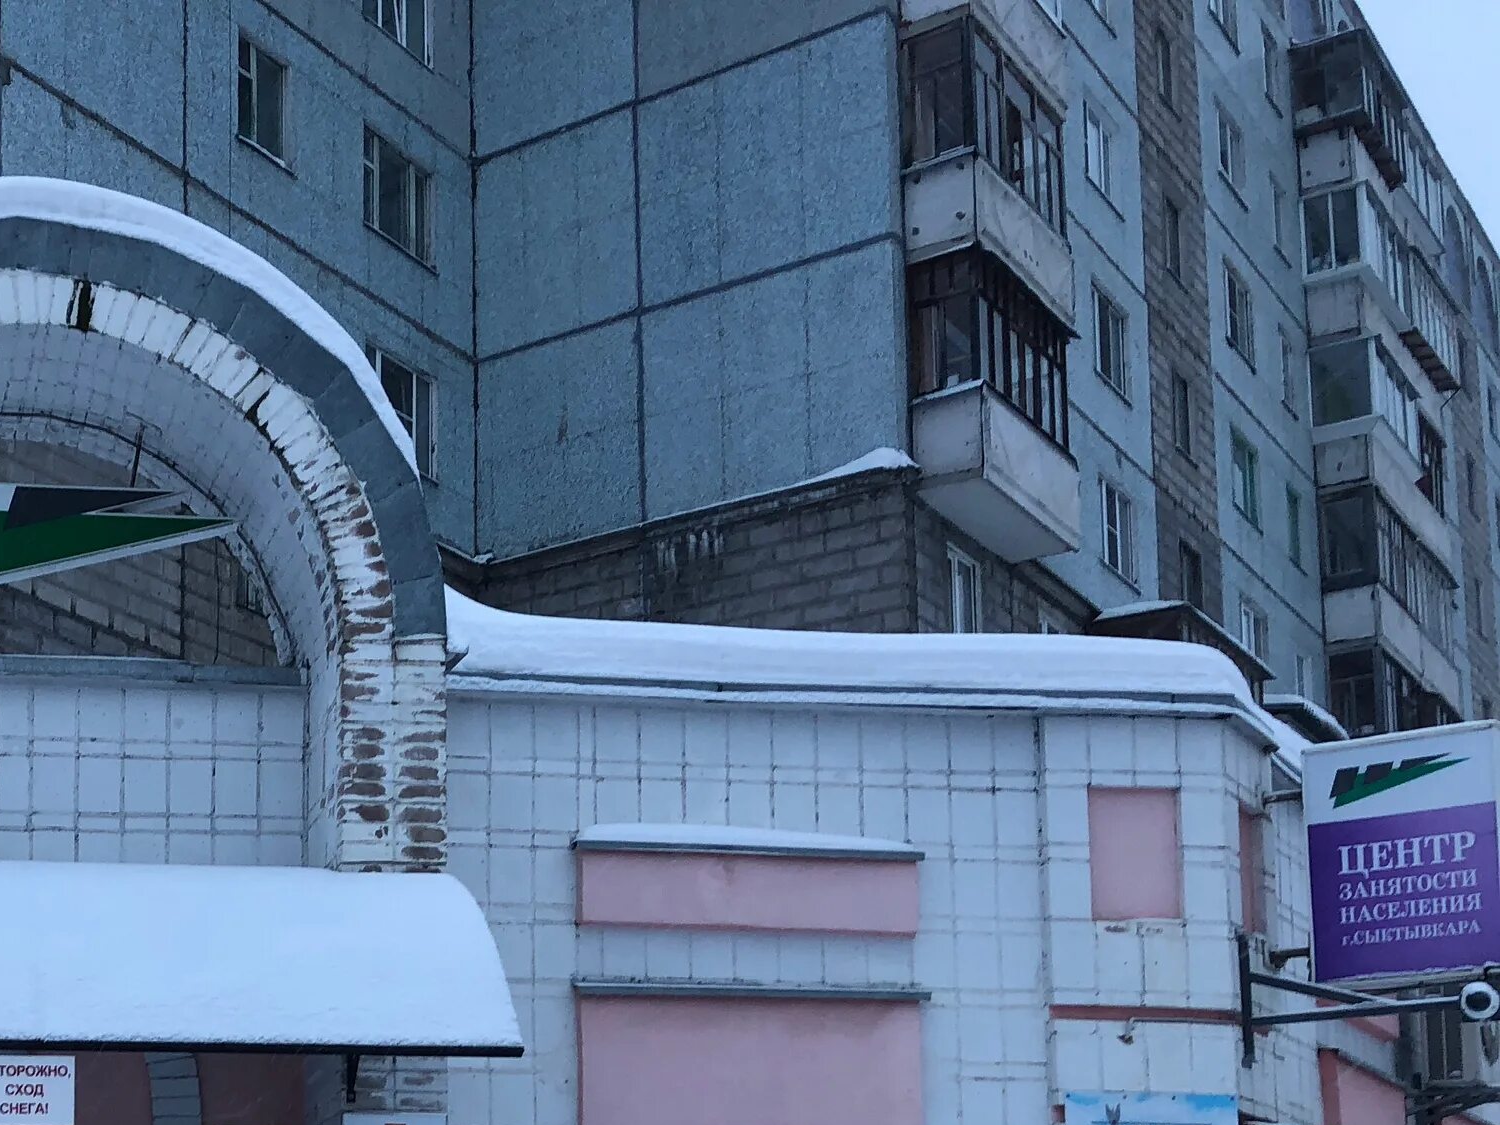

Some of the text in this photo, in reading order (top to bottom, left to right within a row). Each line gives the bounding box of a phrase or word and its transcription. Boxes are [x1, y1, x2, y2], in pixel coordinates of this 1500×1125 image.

[1337, 830, 1476, 879] ЦЕНТР
[1338, 868, 1477, 901] ЗАНЯТОСТИ
[1339, 892, 1483, 925] НАСЕЛЕНИЯ
[1341, 919, 1482, 947] г.СЫКТЫВКАРА
[5, 1083, 44, 1097] СХОД
[0, 1102, 49, 1115] СНЕГА!
